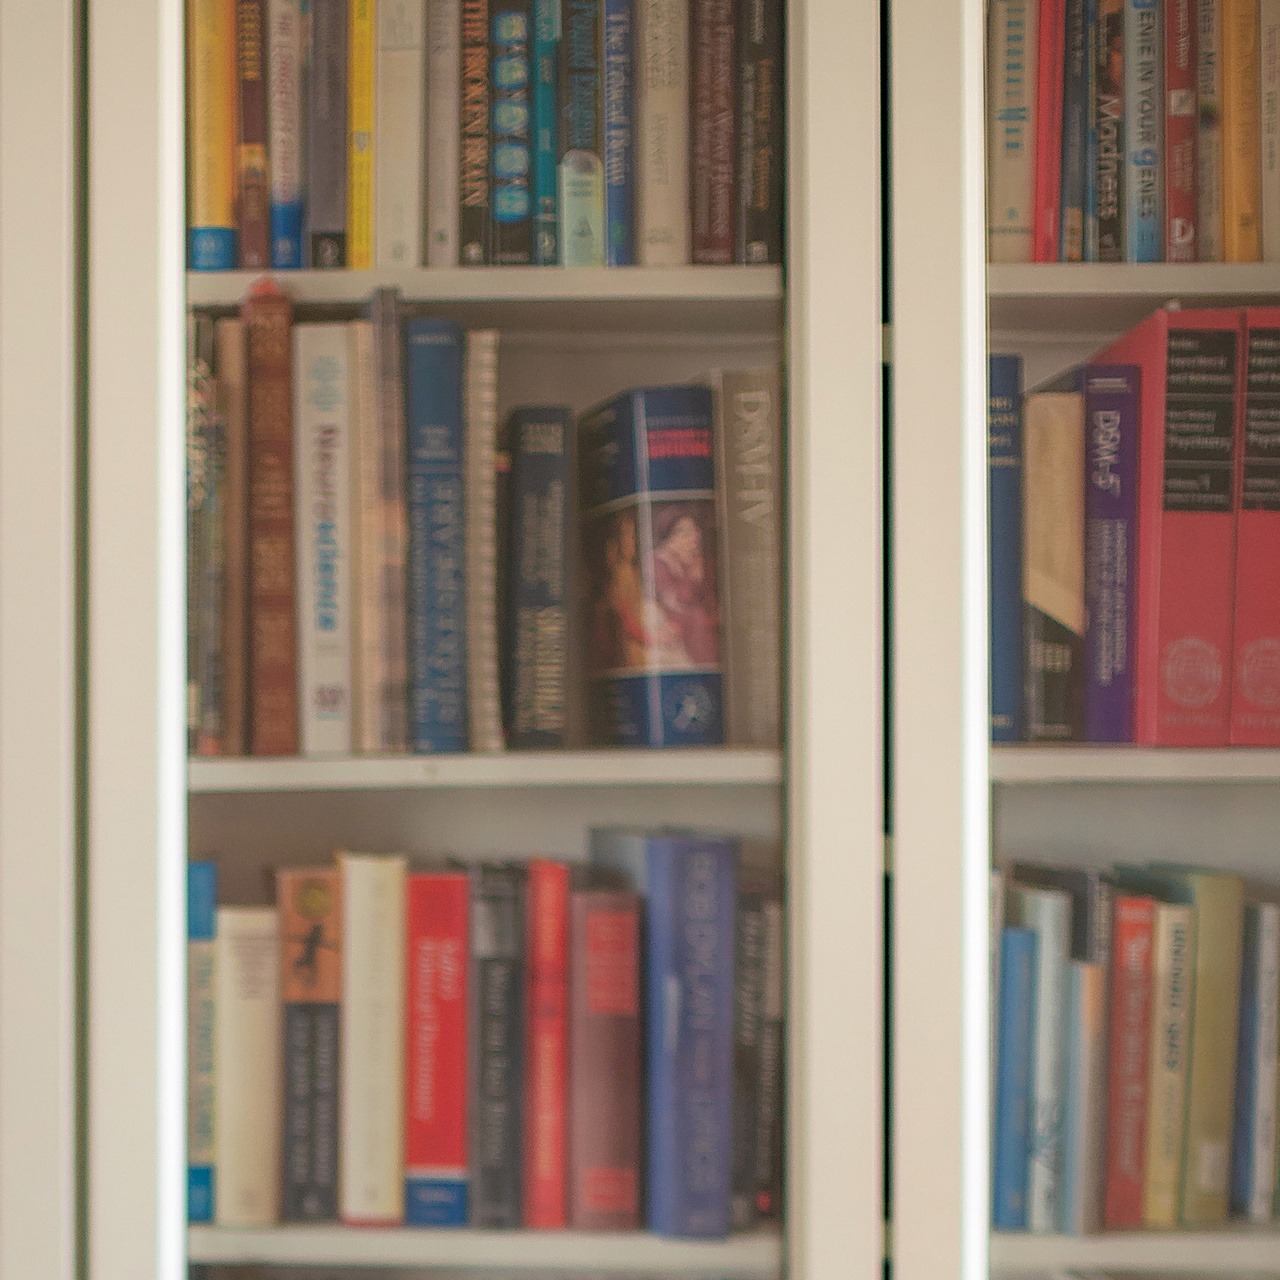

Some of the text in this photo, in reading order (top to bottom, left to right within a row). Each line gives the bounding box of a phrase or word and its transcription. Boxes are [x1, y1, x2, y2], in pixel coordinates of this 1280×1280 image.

[1098, 96, 1123, 220] Madness
[313, 423, 341, 633] Neuroscience
[686, 852, 719, 920] BOB
[685, 922, 718, 1031] DYLAN
